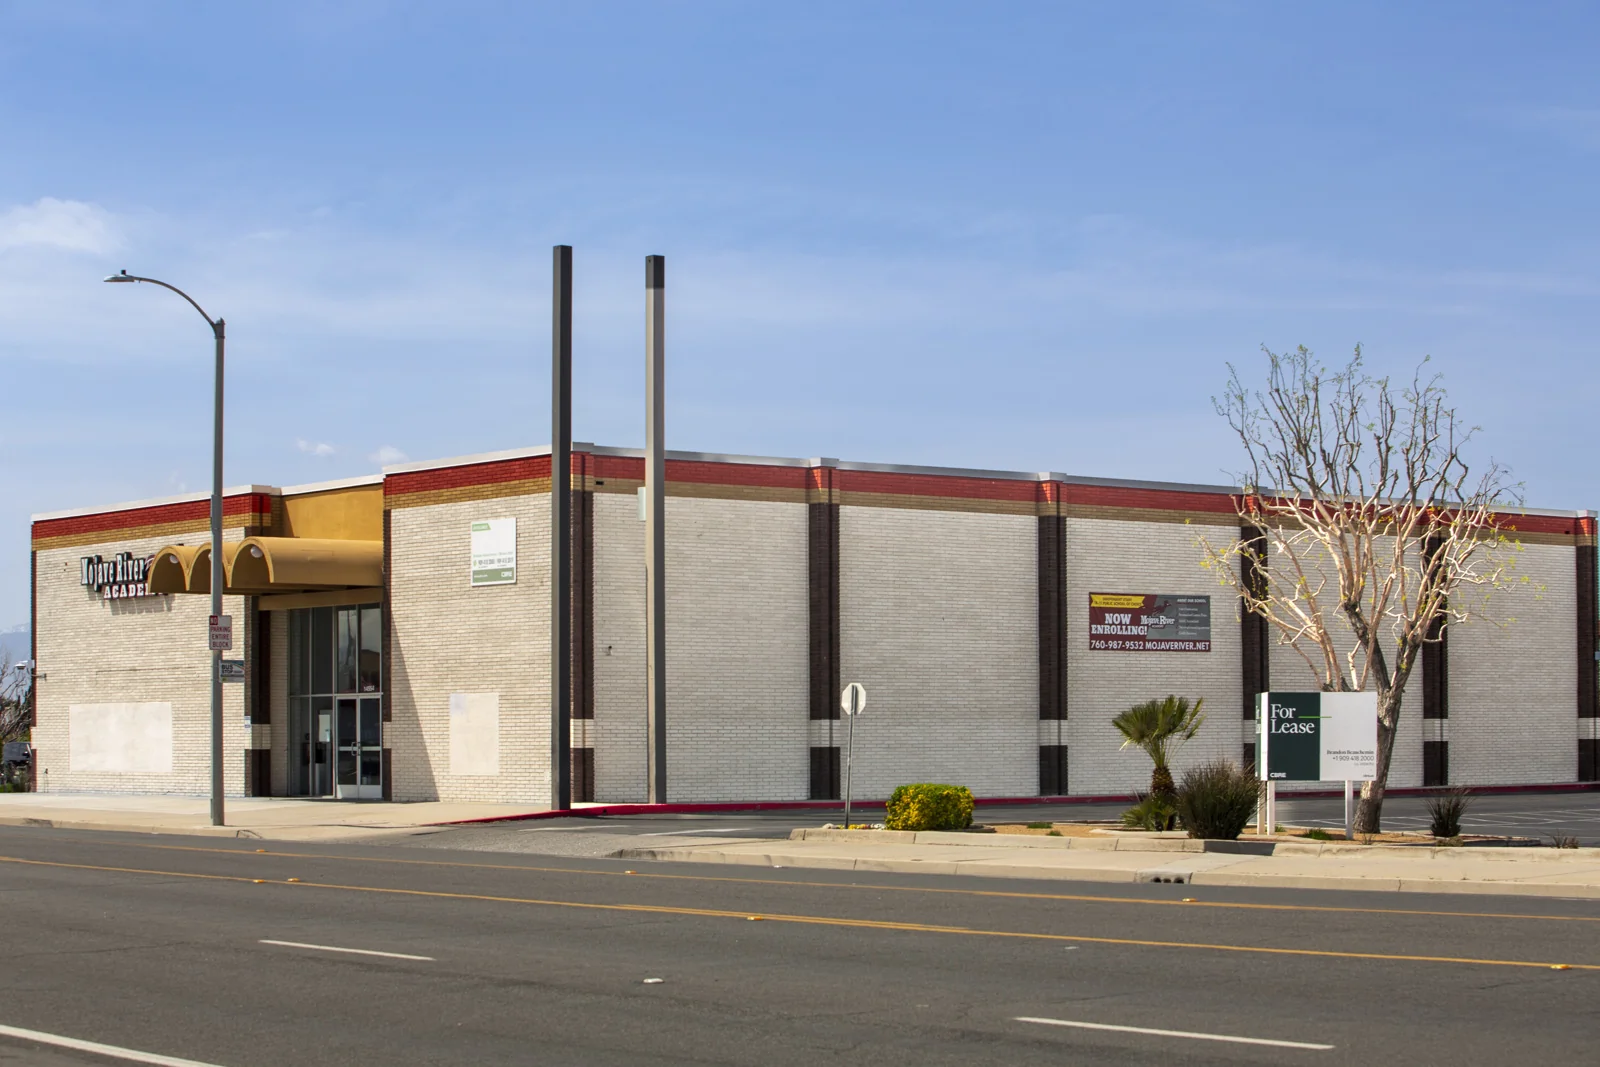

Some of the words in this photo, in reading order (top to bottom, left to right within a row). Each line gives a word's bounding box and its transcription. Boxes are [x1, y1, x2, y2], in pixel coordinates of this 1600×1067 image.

[81, 555, 115, 592] Mojave
[115, 552, 146, 582] River
[104, 583, 163, 599] ACADE
[1105, 613, 1131, 624] NOW
[1140, 615, 1159, 626] Mojave
[1160, 615, 1175, 625] River
[1091, 624, 1147, 635] ENROLLING!
[1091, 640, 1144, 649] 760-987-9532
[1145, 641, 1210, 651] MOJAVERIVER.NET
[1270, 703, 1296, 718] For
[1270, 718, 1316, 734] Lease
